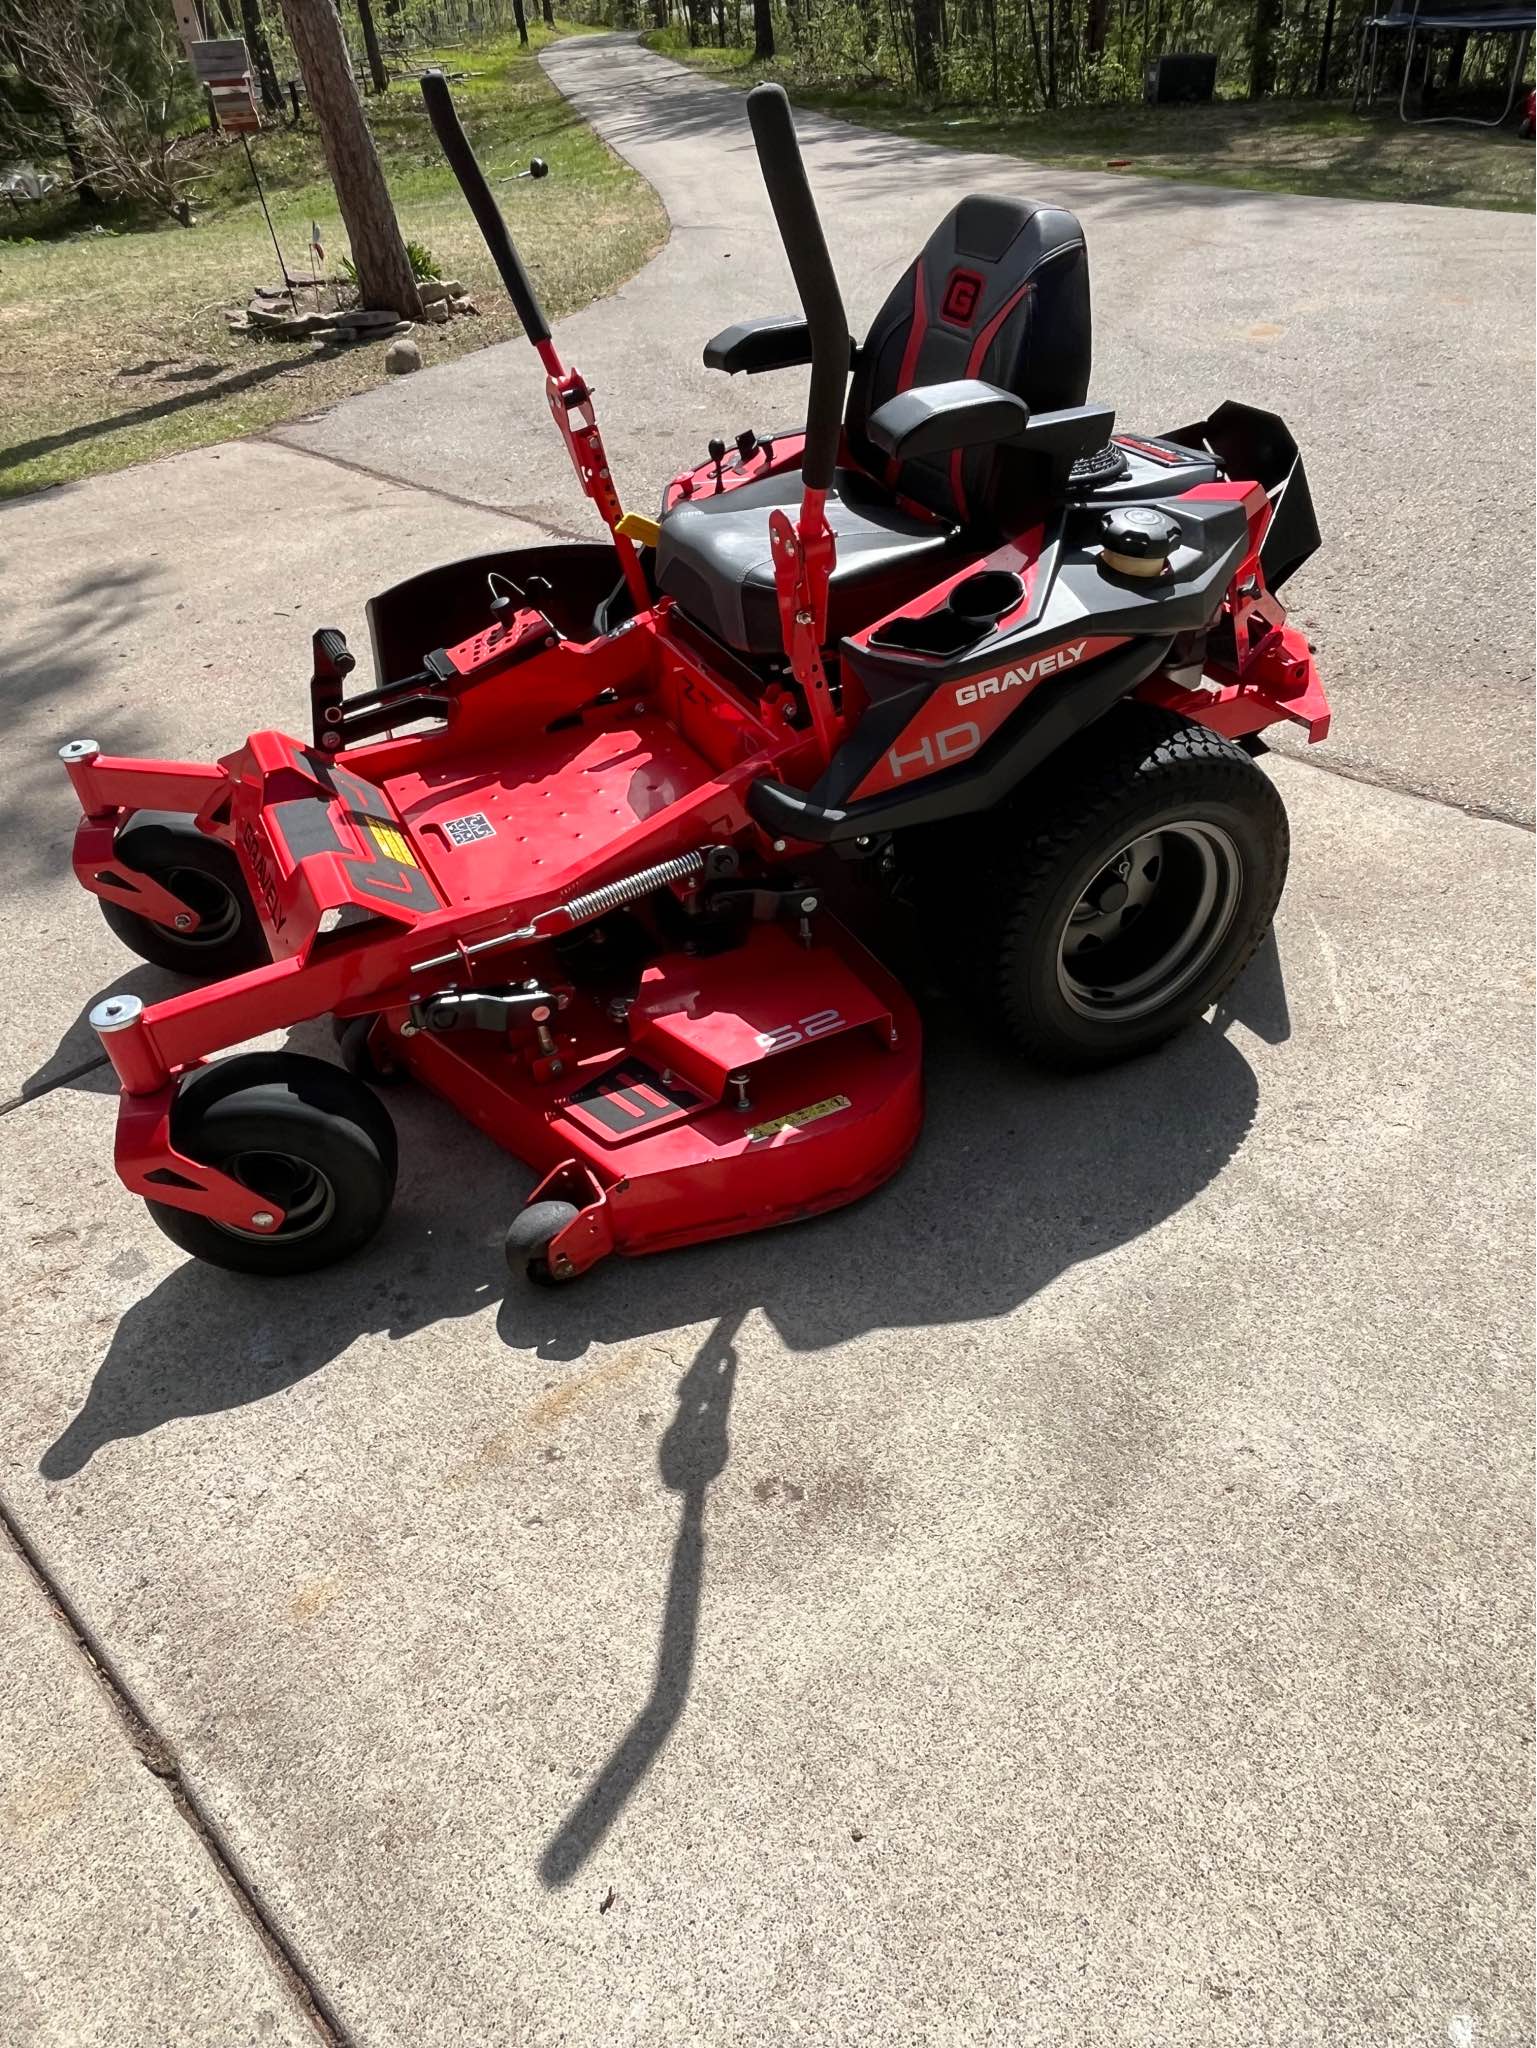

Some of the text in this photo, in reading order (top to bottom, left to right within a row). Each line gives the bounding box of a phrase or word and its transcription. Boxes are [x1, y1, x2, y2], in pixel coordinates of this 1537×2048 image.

[946, 277, 980, 318] G
[955, 640, 1088, 707] GRAVELY
[888, 720, 981, 777] HD
[754, 1009, 846, 1054] 52
